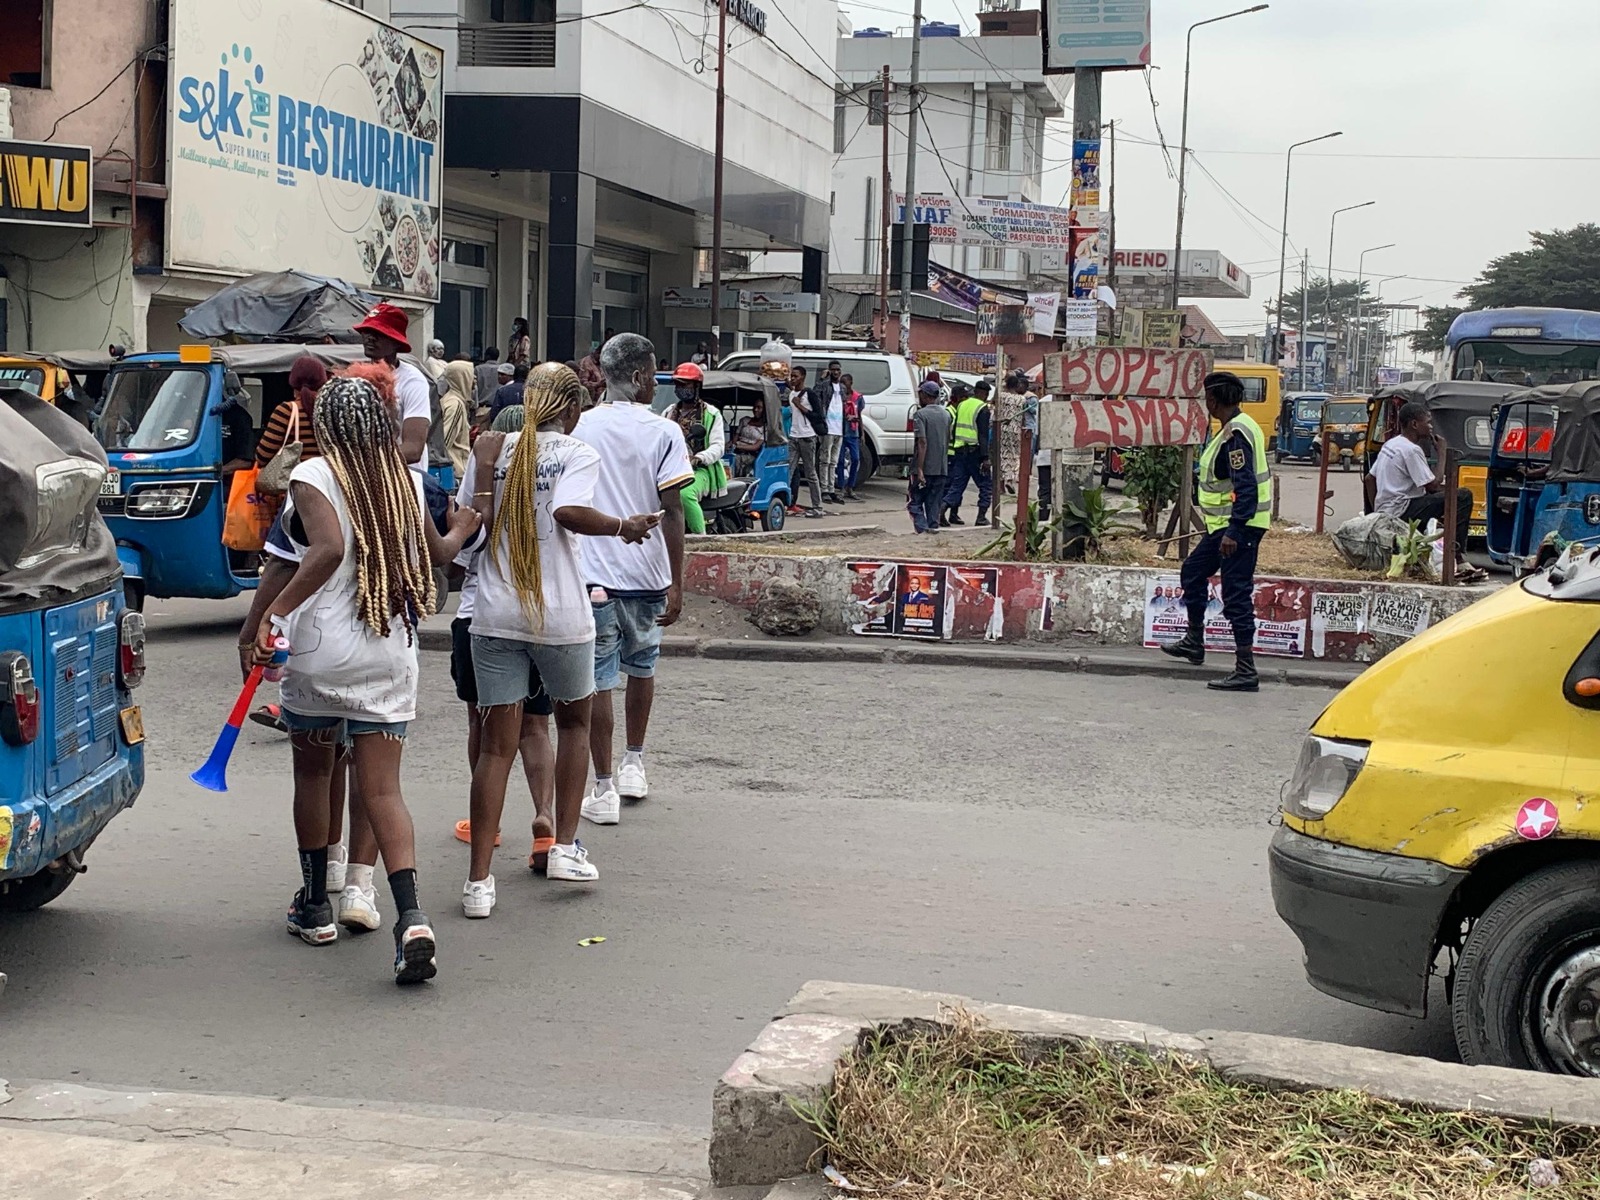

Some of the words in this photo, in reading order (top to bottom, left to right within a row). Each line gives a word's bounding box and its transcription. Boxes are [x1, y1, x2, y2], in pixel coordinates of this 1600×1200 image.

[224, 142, 244, 157] SUPER
[277, 95, 434, 202] RESTAURANT
[4, 154, 88, 213] WU
[895, 194, 951, 208] Inriptions
[992, 207, 1046, 220] FORMATIONS
[1009, 233, 1045, 243] PASSATION
[1047, 235, 1060, 244] DES
[1070, 399, 1208, 449] LEMBA
[164, 428, 189, 440] R
[1317, 599, 1327, 609] EN
[1329, 600, 1335, 608] 2
[1337, 600, 1362, 610] MOIS
[1377, 598, 1387, 607] EN
[1389, 600, 1395, 608] 2
[1398, 602, 1422, 614] MOIS
[1152, 615, 1189, 625] Famille
[1374, 605, 1420, 621] ANGLAIS
[1258, 621, 1301, 632] Familles
